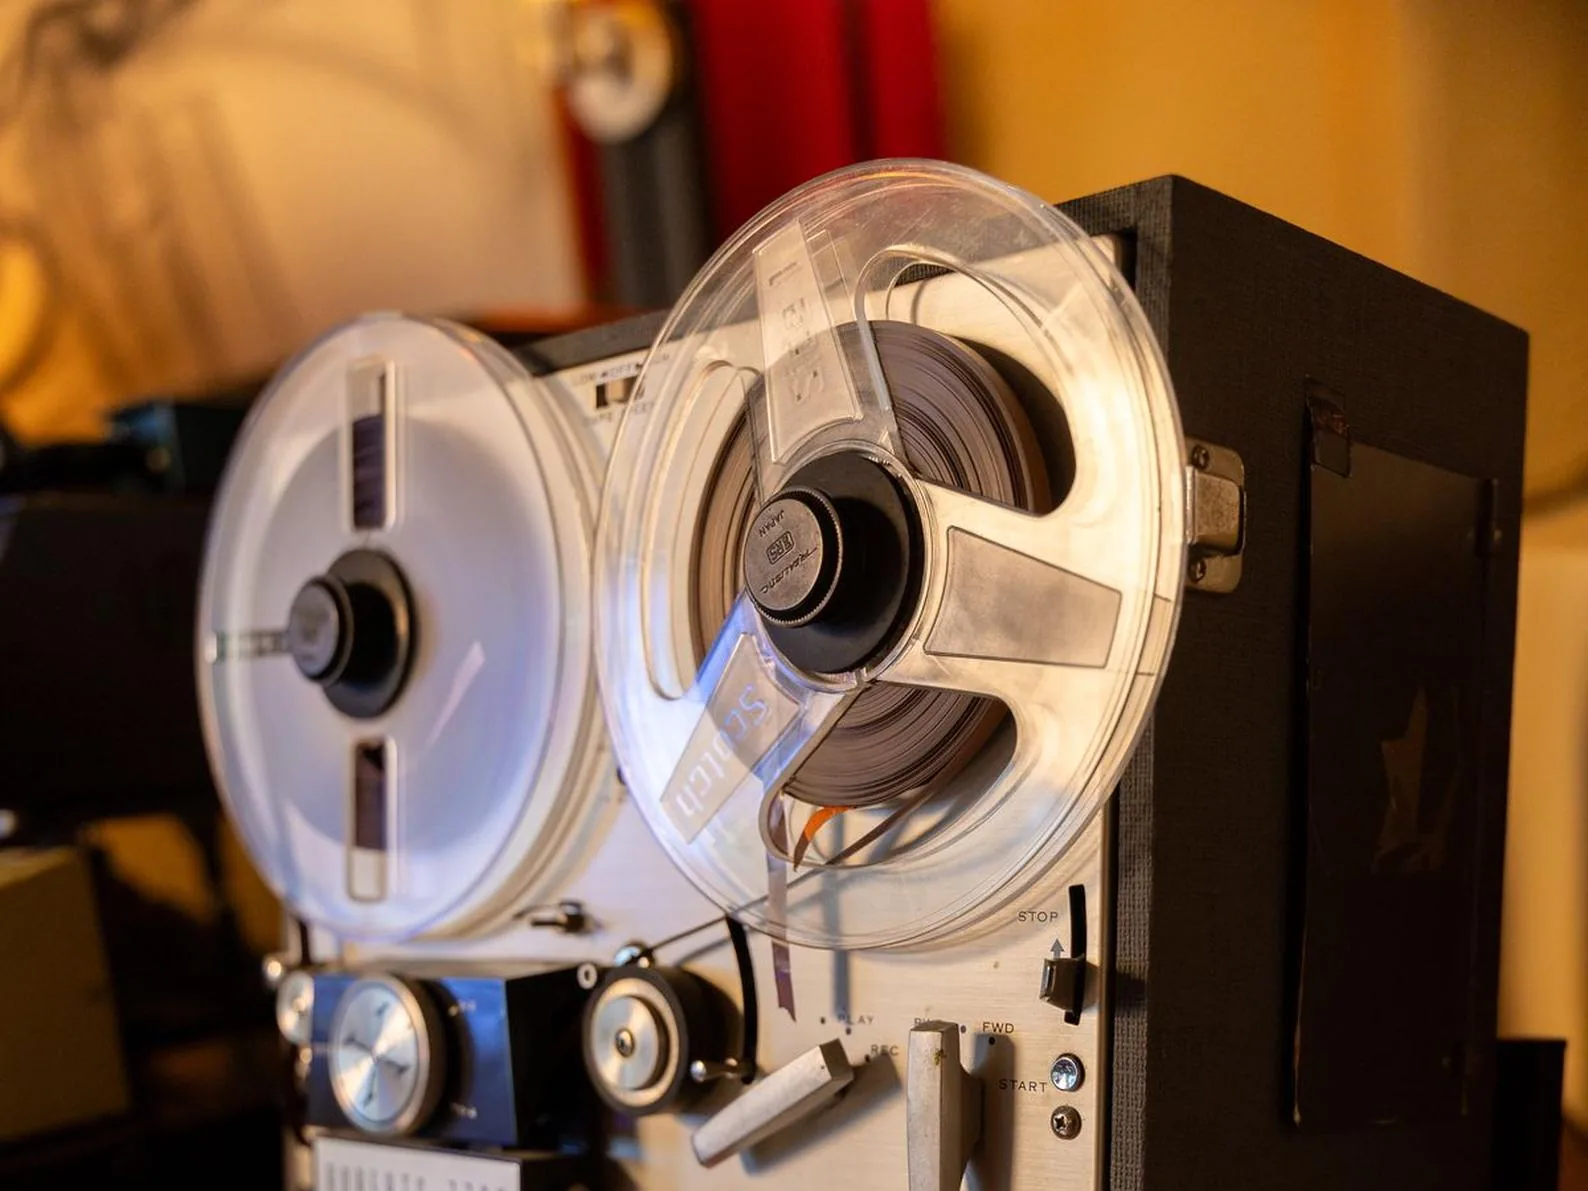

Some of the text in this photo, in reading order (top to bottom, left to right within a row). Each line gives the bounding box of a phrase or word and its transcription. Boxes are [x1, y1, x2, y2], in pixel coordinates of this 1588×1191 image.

[759, 509, 785, 538] JAPAN
[1018, 911, 1059, 923] STOP
[837, 1013, 875, 1026] PLAY
[982, 1021, 1015, 1034] FWD
[870, 1043, 900, 1056] REC
[998, 1079, 1048, 1093] START
